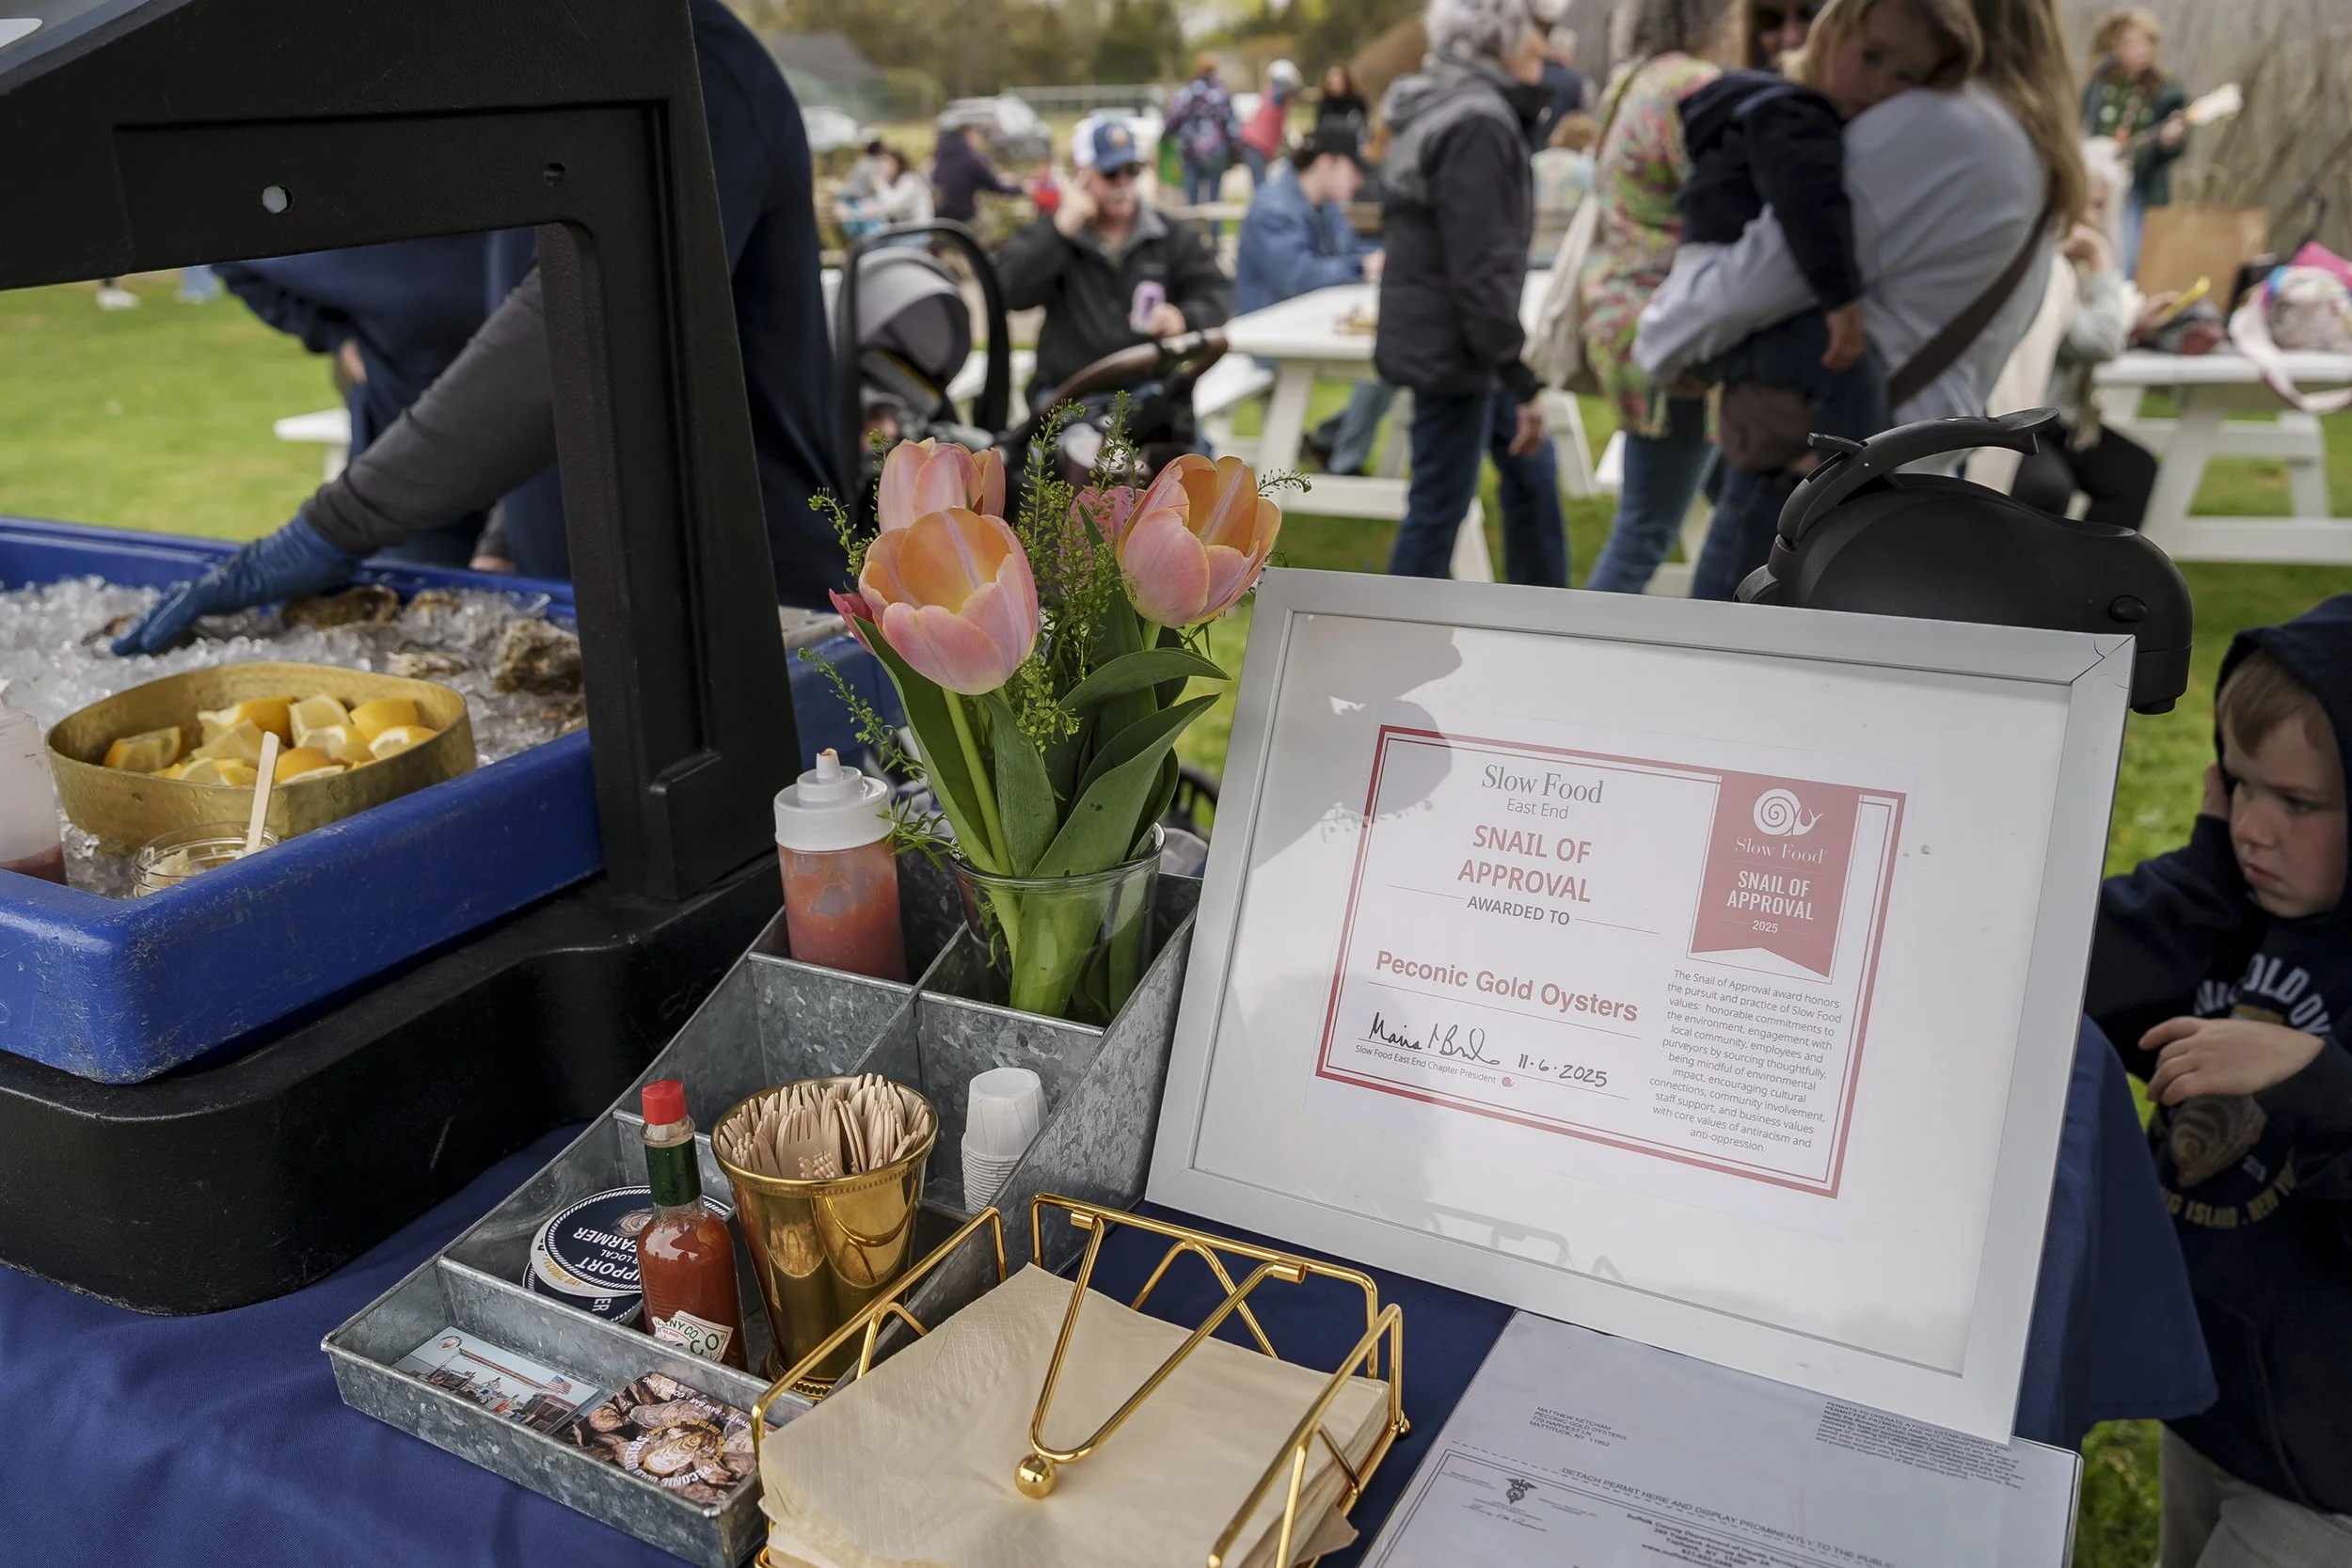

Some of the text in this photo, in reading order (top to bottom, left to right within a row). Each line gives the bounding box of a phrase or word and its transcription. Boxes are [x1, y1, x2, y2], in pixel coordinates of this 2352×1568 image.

[1481, 764, 1604, 804] Slow Food
[1506, 798, 1569, 819] East End
[1472, 824, 1592, 864] SNAIL OF
[1735, 837, 1827, 864] Slow Food
[1456, 859, 1591, 903] APPROVAL
[1738, 870, 1811, 897] SNAIL OF
[1466, 895, 1570, 926] AWARDED TO
[1726, 889, 1814, 921] APPROVAL
[1752, 919, 1778, 934] 2025
[1375, 950, 1638, 1022] Peconic Gold Oysters
[1674, 969, 1840, 1009] The Snail of Approval award honors
[2244, 953, 2310, 1005] OLD
[1667, 982, 1842, 1023] the pursuit and practice of Slow Food
[1669, 998, 1836, 1037] values: honorable commitments to
[1666, 1010, 1833, 1053] the environment, engagement with
[1670, 1023, 1823, 1064] local community, employees and
[1355, 1044, 1497, 1085] Slow Food East End Chapter President
[1661, 1038, 1827, 1081] purveyors by sourcing thoughtfully,
[1668, 1052, 1817, 1091] being mindful of environmental
[1649, 1078, 1825, 1123] connections, community involvement,
[1672, 1067, 1807, 1103] impact, encouraging cultural
[1652, 1105, 1812, 1148] with core values of antiracism and
[1655, 1092, 1815, 1134] staff support, and business values
[1690, 1129, 1766, 1153] anti-oppression.
[573, 1227, 638, 1253] FARMER
[601, 1248, 631, 1263] LOCAL
[690, 1398, 706, 1409] BAR
[705, 1403, 723, 1415] RAW
[726, 1414, 753, 1429] RIVATE
[1534, 1411, 1626, 1440] PECONIC GOLD OYSTERS
[660, 1465, 712, 1488] PECONIC
[1562, 1467, 1601, 1483] DETACH
[1603, 1480, 1640, 1495] PERMIT
[1642, 1491, 1668, 1503] HERE
[1671, 1500, 1692, 1510] AND
[1694, 1506, 1737, 1523] DISPLAY
[1740, 1519, 1816, 1544] PROMINENTLY
[1818, 1542, 1831, 1550] TO
